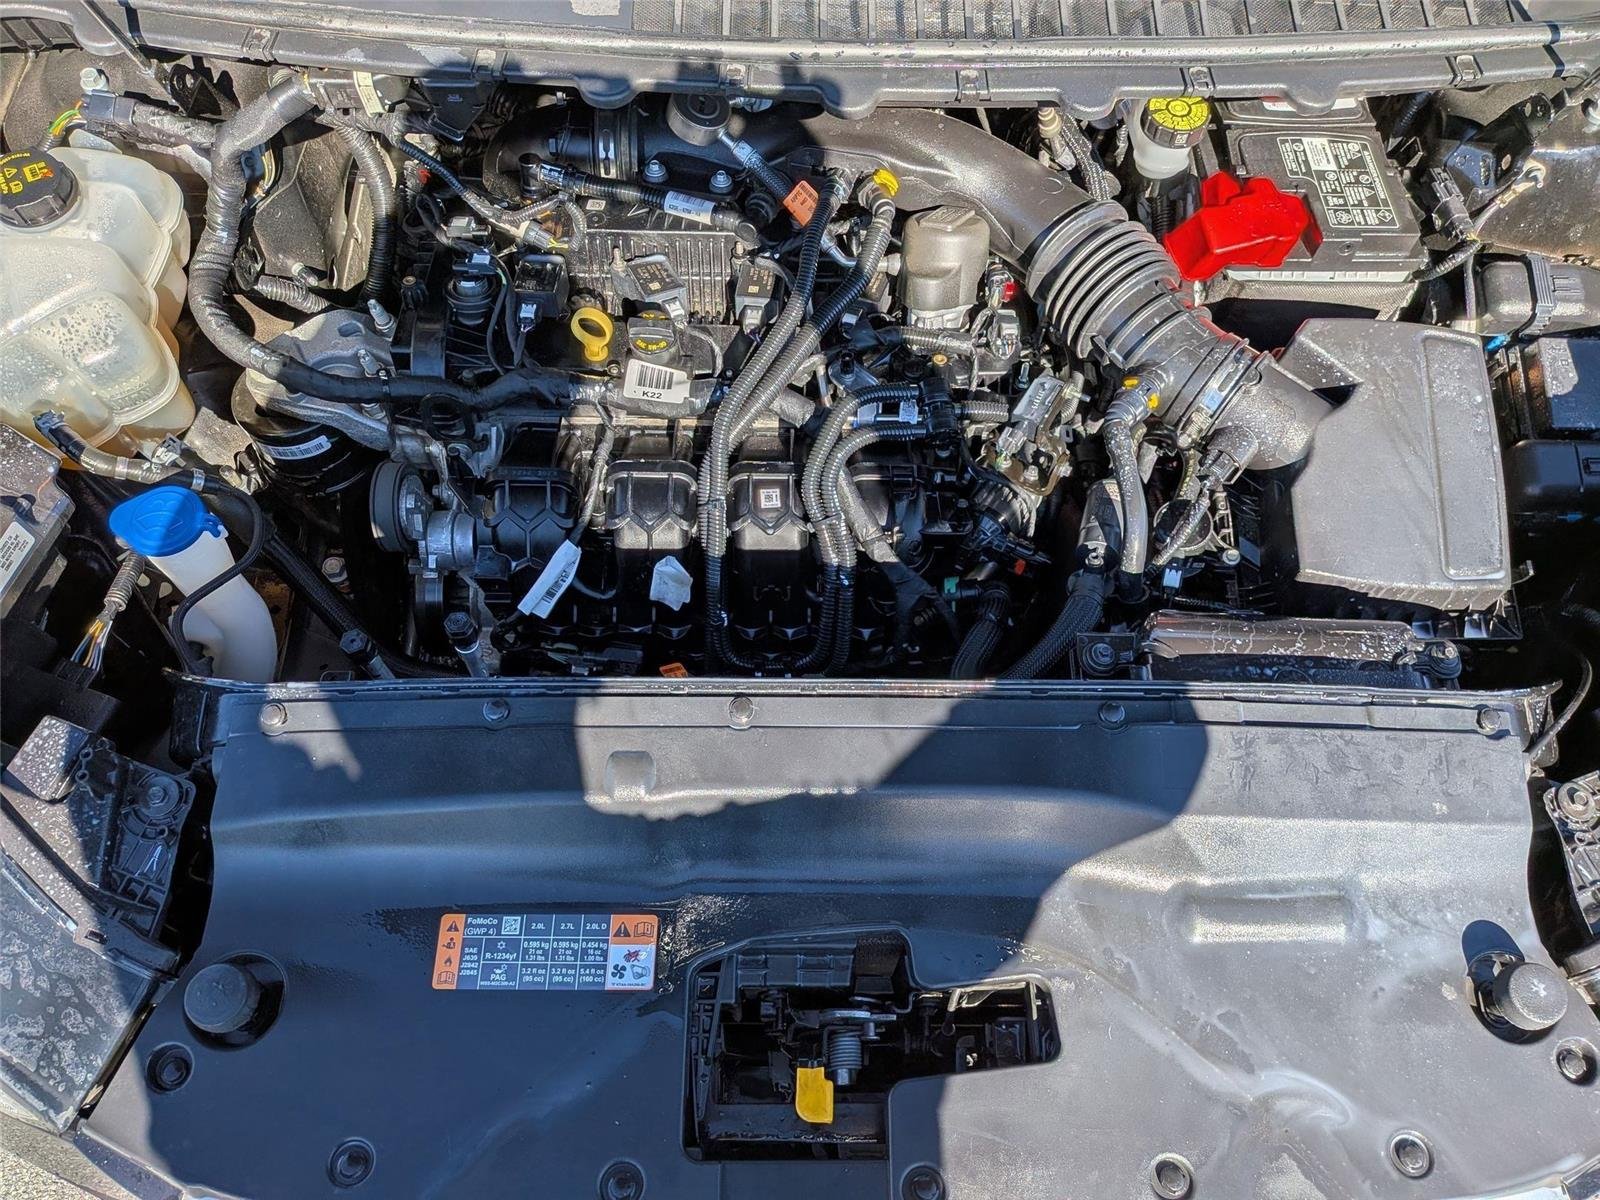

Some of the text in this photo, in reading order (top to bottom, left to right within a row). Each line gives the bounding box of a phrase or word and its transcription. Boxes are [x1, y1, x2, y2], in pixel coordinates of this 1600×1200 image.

[642, 390, 662, 399] K22
[467, 917, 498, 925] FoMoCo
[464, 927, 497, 936] (GWP 4)
[541, 941, 549, 949] kg
[570, 941, 579, 949] kg
[599, 941, 608, 950] kg
[485, 952, 517, 960] R-1234yf
